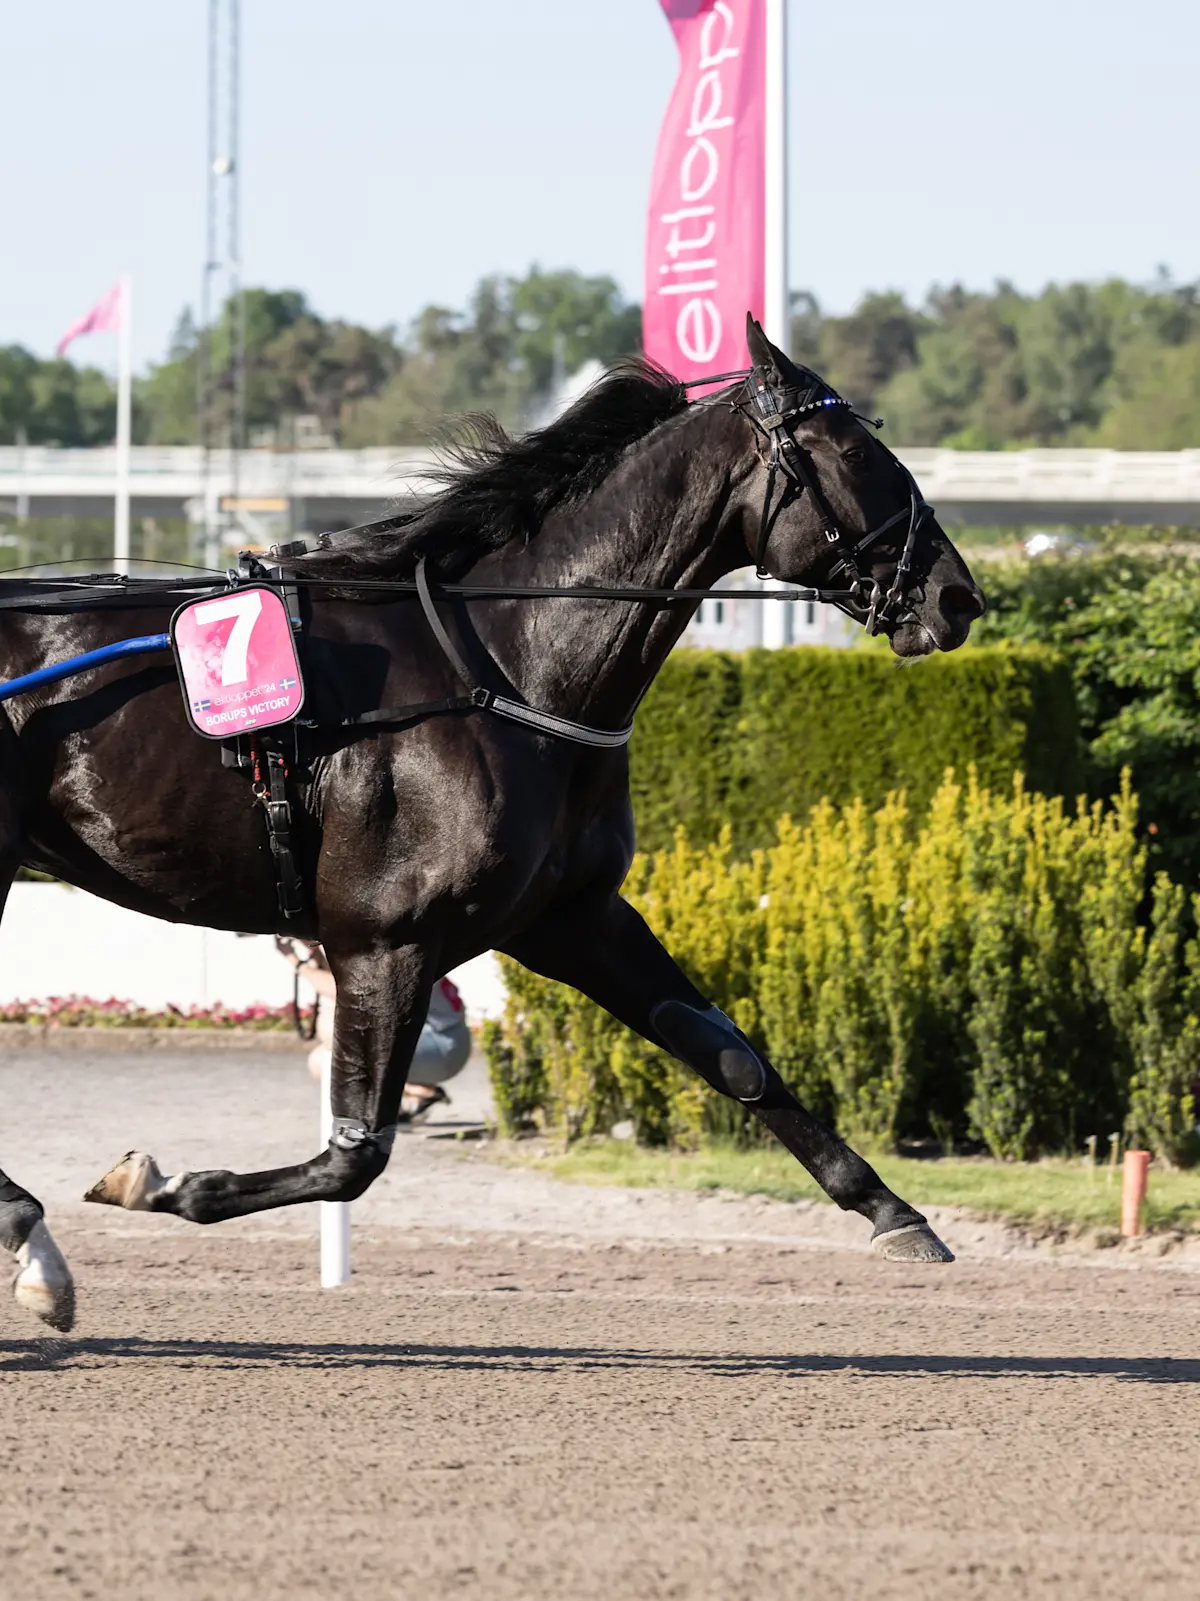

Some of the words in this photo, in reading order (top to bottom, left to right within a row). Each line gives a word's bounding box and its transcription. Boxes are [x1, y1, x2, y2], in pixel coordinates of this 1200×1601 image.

[193, 591, 263, 687] 7
[205, 707, 248, 727] BORUPS
[247, 695, 290, 716] VICTORY
